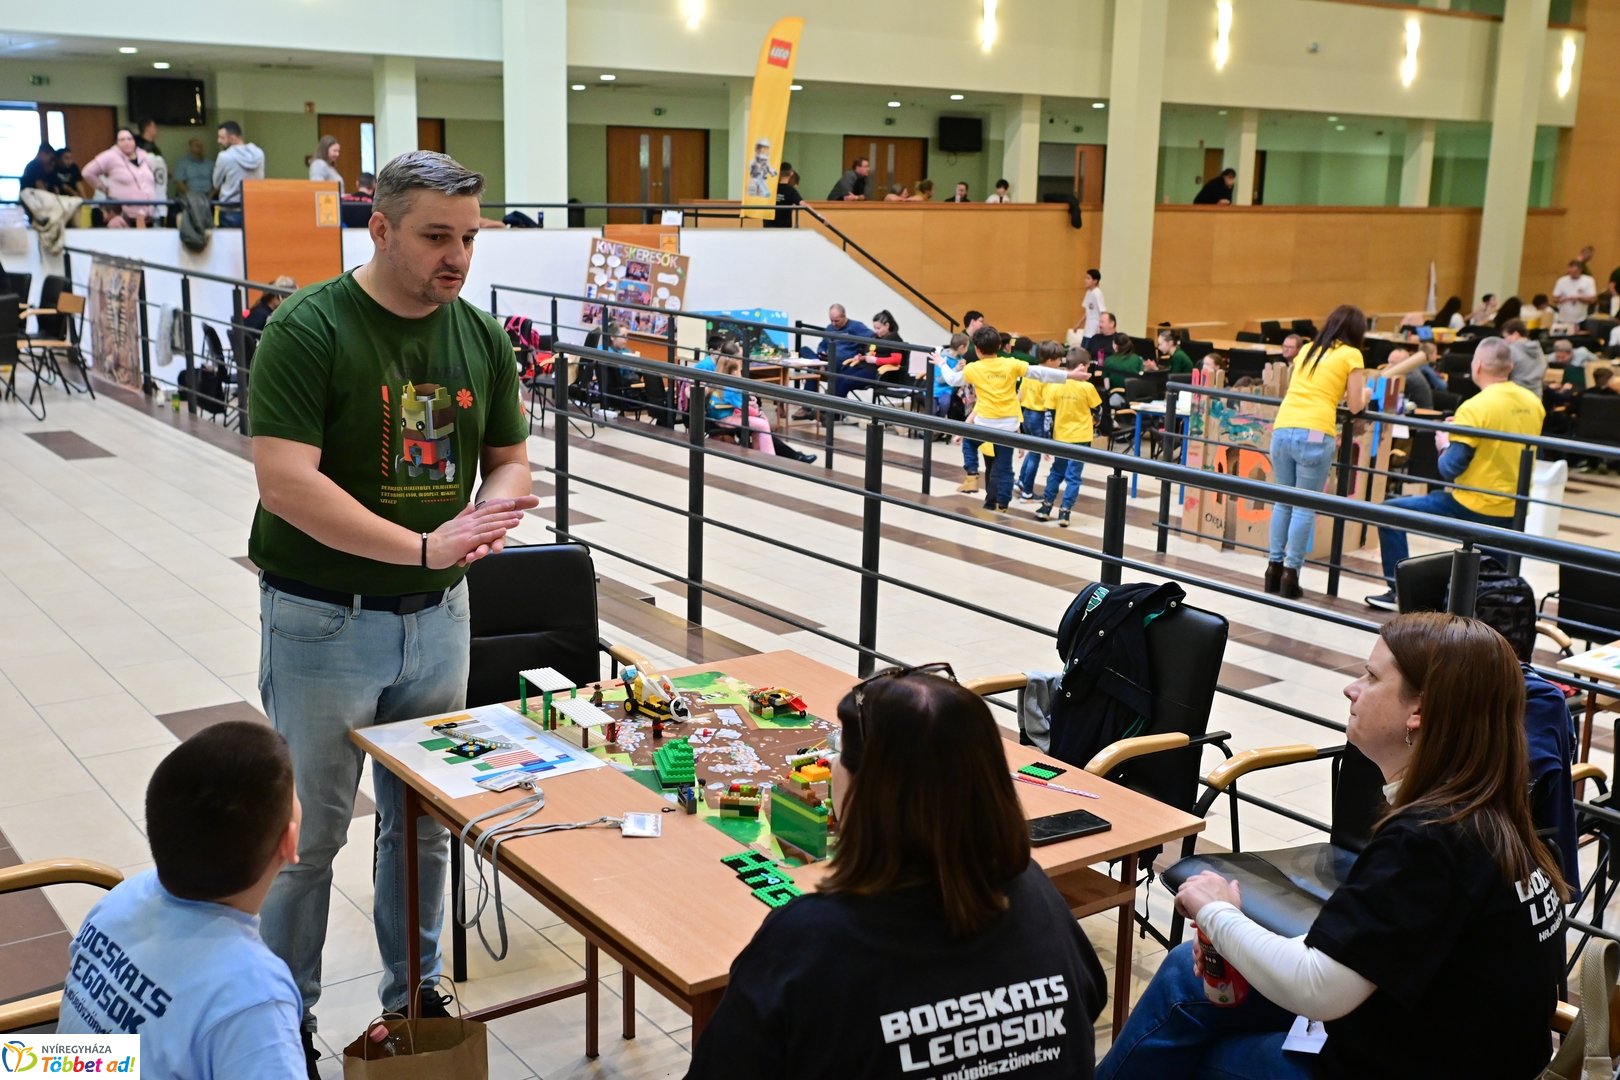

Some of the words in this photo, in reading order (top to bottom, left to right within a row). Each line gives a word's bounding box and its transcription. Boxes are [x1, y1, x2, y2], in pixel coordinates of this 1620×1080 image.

[71, 953, 147, 1034] EGOSOK
[880, 974, 1069, 1044] BOCSKAIS
[899, 1007, 1067, 1073] LEGOSOK
